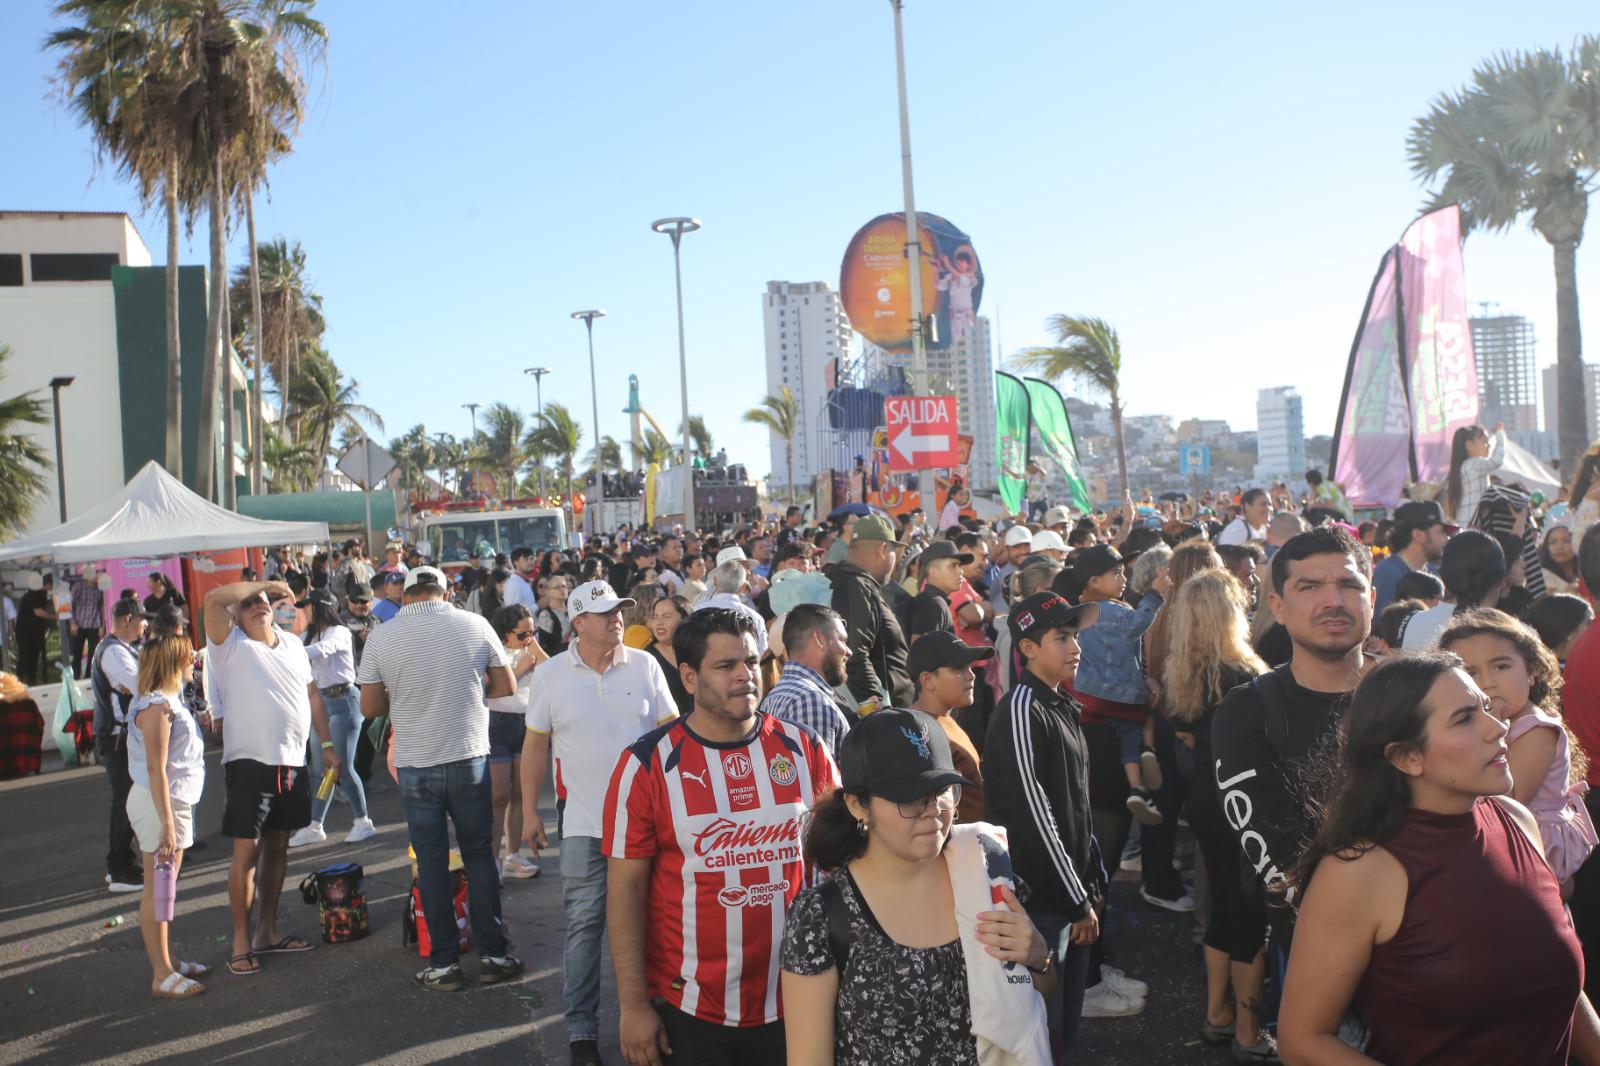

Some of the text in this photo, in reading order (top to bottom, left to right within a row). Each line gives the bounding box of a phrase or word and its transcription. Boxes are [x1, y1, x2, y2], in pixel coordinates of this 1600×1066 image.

[888, 399, 949, 424] SALIDA
[726, 755, 749, 777] MG
[729, 785, 756, 794] amazon
[733, 791, 754, 802] prime
[691, 817, 801, 857] Caliente
[704, 845, 801, 869] caliente.mx
[750, 881, 789, 895] mercado
[751, 892, 774, 905] pago
[1006, 974, 1031, 985] FUROR
